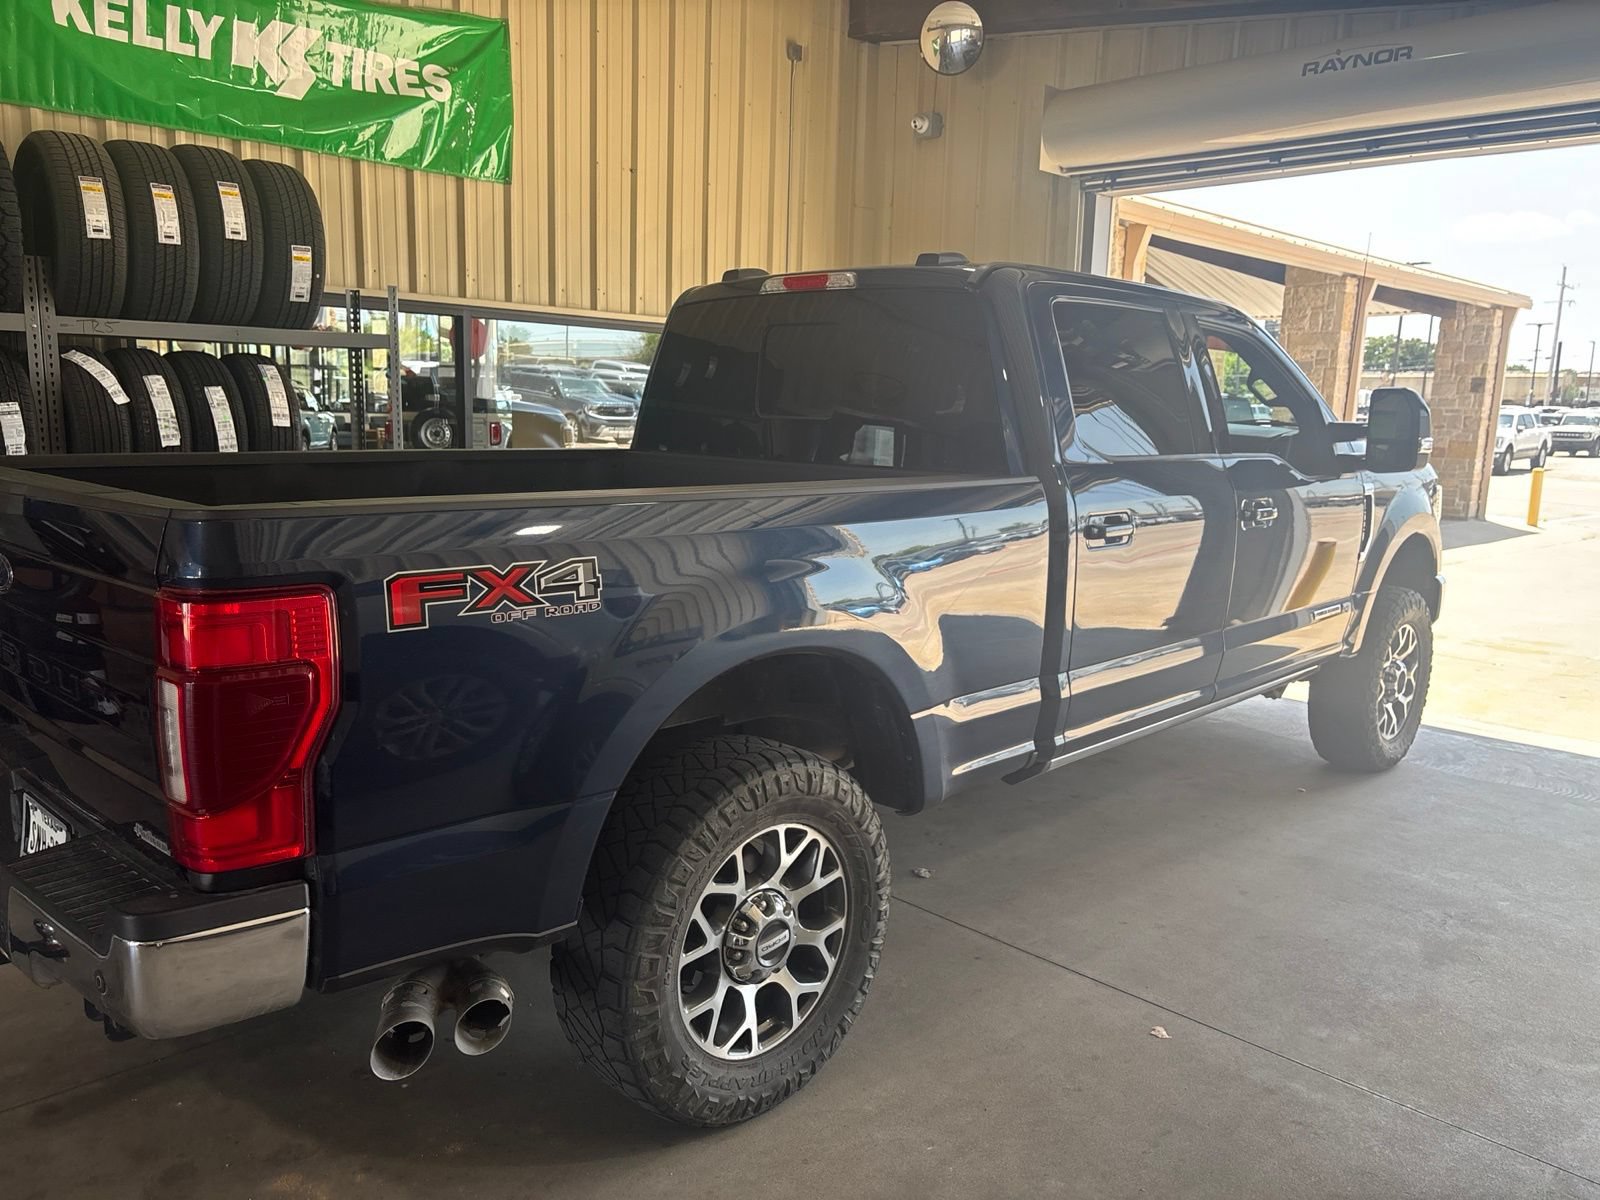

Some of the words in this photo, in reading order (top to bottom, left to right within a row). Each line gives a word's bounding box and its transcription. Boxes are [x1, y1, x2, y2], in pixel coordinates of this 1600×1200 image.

[51, 0, 225, 61] KELLY
[326, 41, 452, 102] TIRES
[1301, 45, 1413, 76] RAYNOR
[384, 556, 602, 633] FX4
[490, 609, 537, 624] OFF
[545, 601, 602, 617] ROAD
